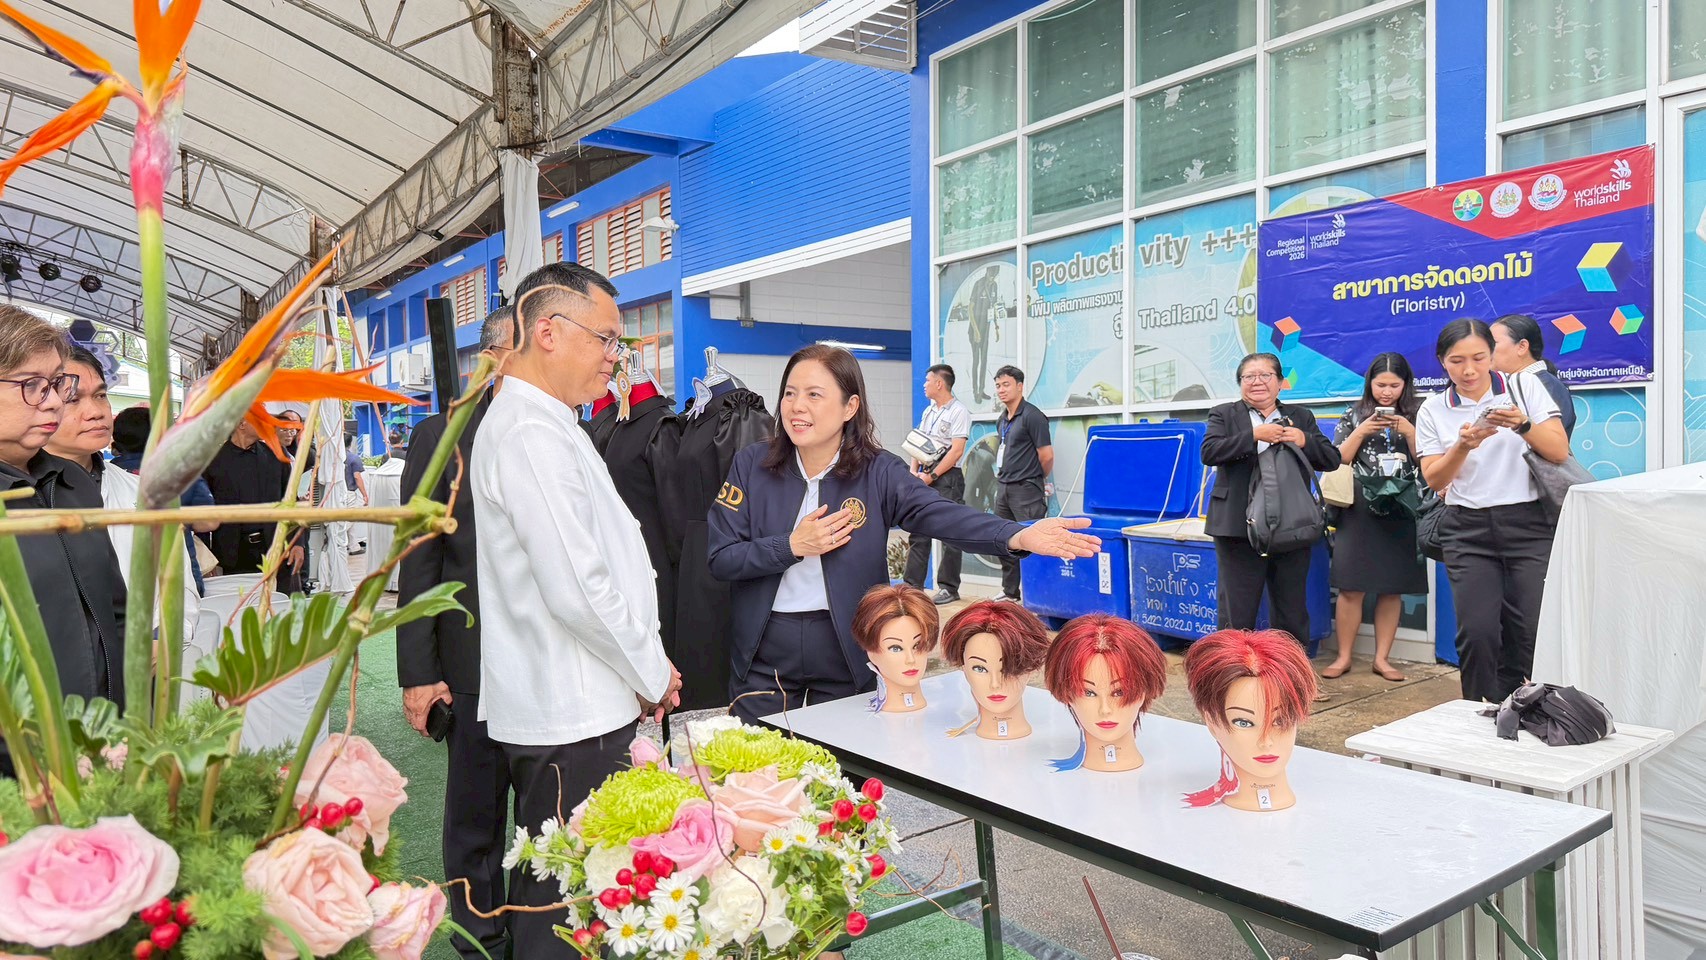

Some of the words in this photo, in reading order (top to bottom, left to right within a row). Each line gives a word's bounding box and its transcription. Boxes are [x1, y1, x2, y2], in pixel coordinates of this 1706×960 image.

[1573, 179, 1632, 199] worldskills
[1574, 191, 1620, 208] Thailand
[1277, 236, 1305, 248] Regional
[1309, 228, 1346, 242] worldskills
[1266, 244, 1305, 257] Competition
[1310, 238, 1339, 249] Thailand
[1289, 251, 1305, 260] 2026
[1332, 250, 1533, 301] สาขาการจัดดอกไม้
[1390, 291, 1466, 316] (Floristry)
[1138, 298, 1218, 329] Thailand
[1224, 293, 1256, 317] 4.0
[1261, 795, 1269, 805] 2
